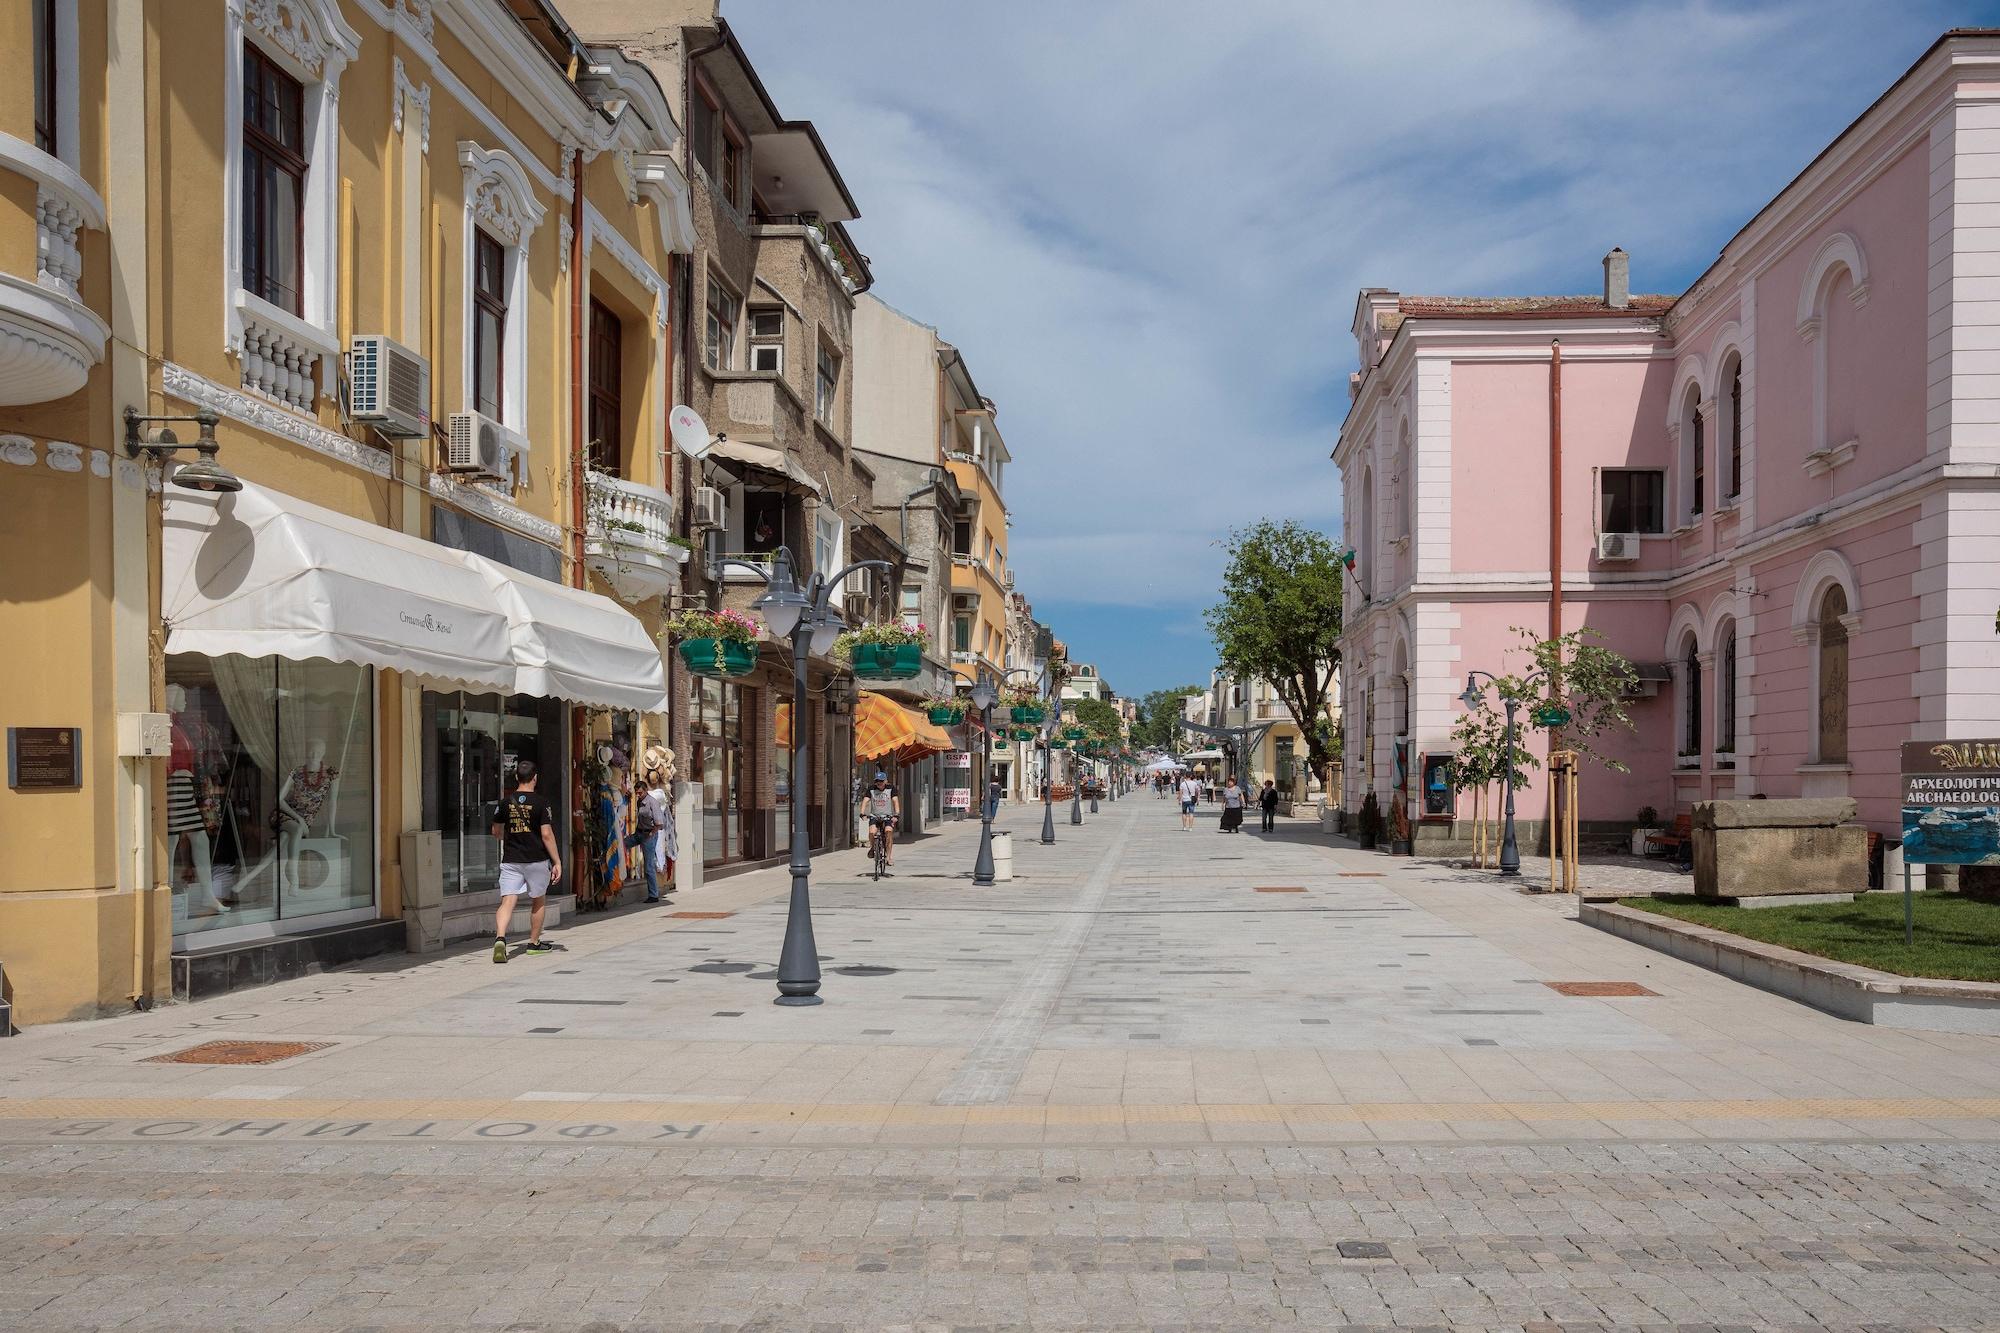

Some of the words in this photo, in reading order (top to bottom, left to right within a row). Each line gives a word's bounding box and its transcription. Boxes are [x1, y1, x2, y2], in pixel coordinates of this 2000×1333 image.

[1910, 778, 2000, 789] АРХЕОЛОГИЧ
[945, 796, 969, 805] СЕРВИЗ
[1907, 792, 1999, 803] ARCHAEOLOG
[50, 1121, 619, 1138] ФОТИНОВ
